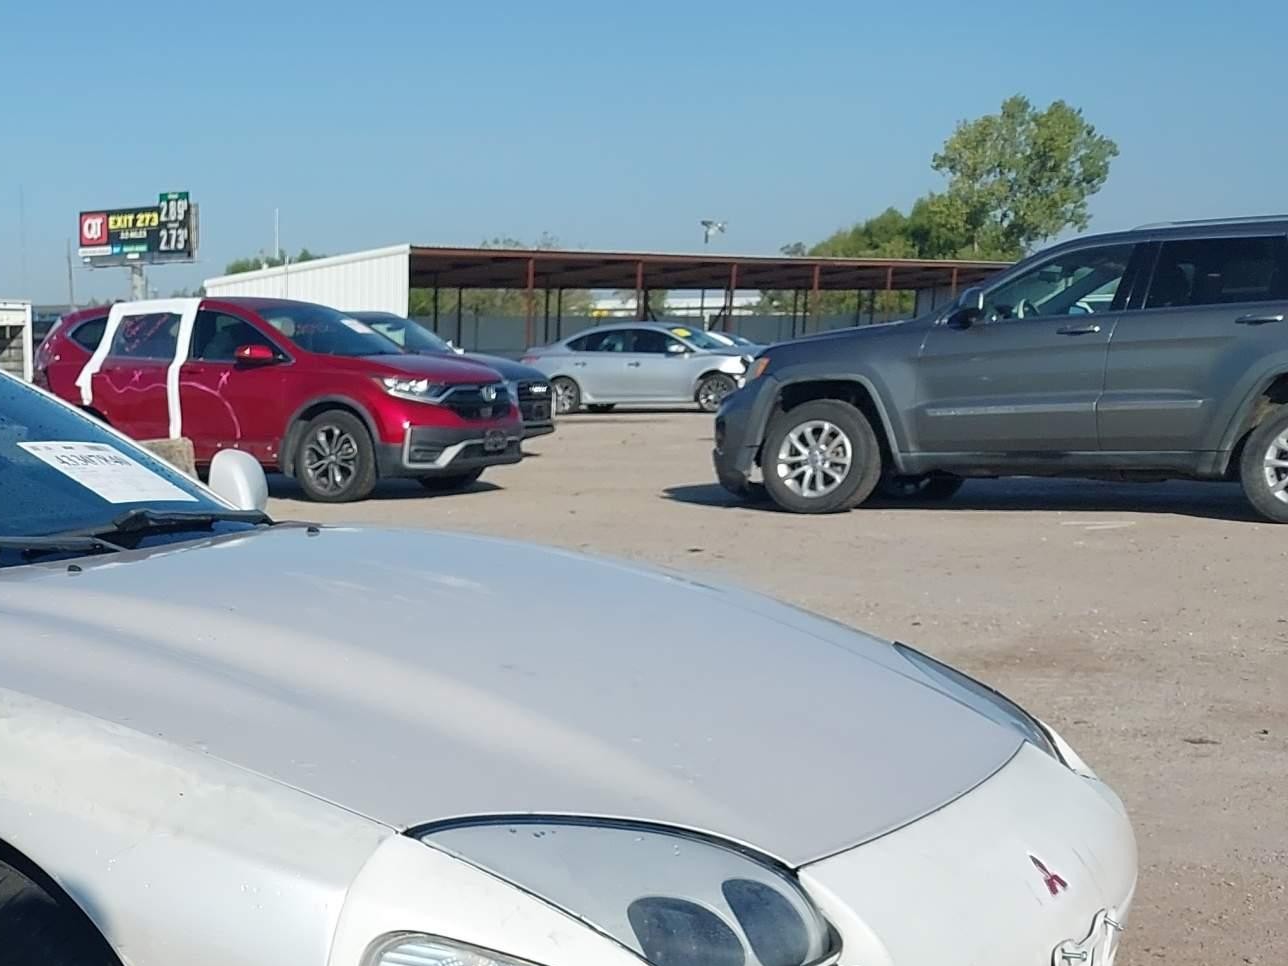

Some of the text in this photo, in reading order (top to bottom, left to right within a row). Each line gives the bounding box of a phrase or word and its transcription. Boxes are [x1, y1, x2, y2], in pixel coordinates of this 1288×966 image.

[83, 217, 103, 240] QT
[108, 212, 158, 229] EXIT 273
